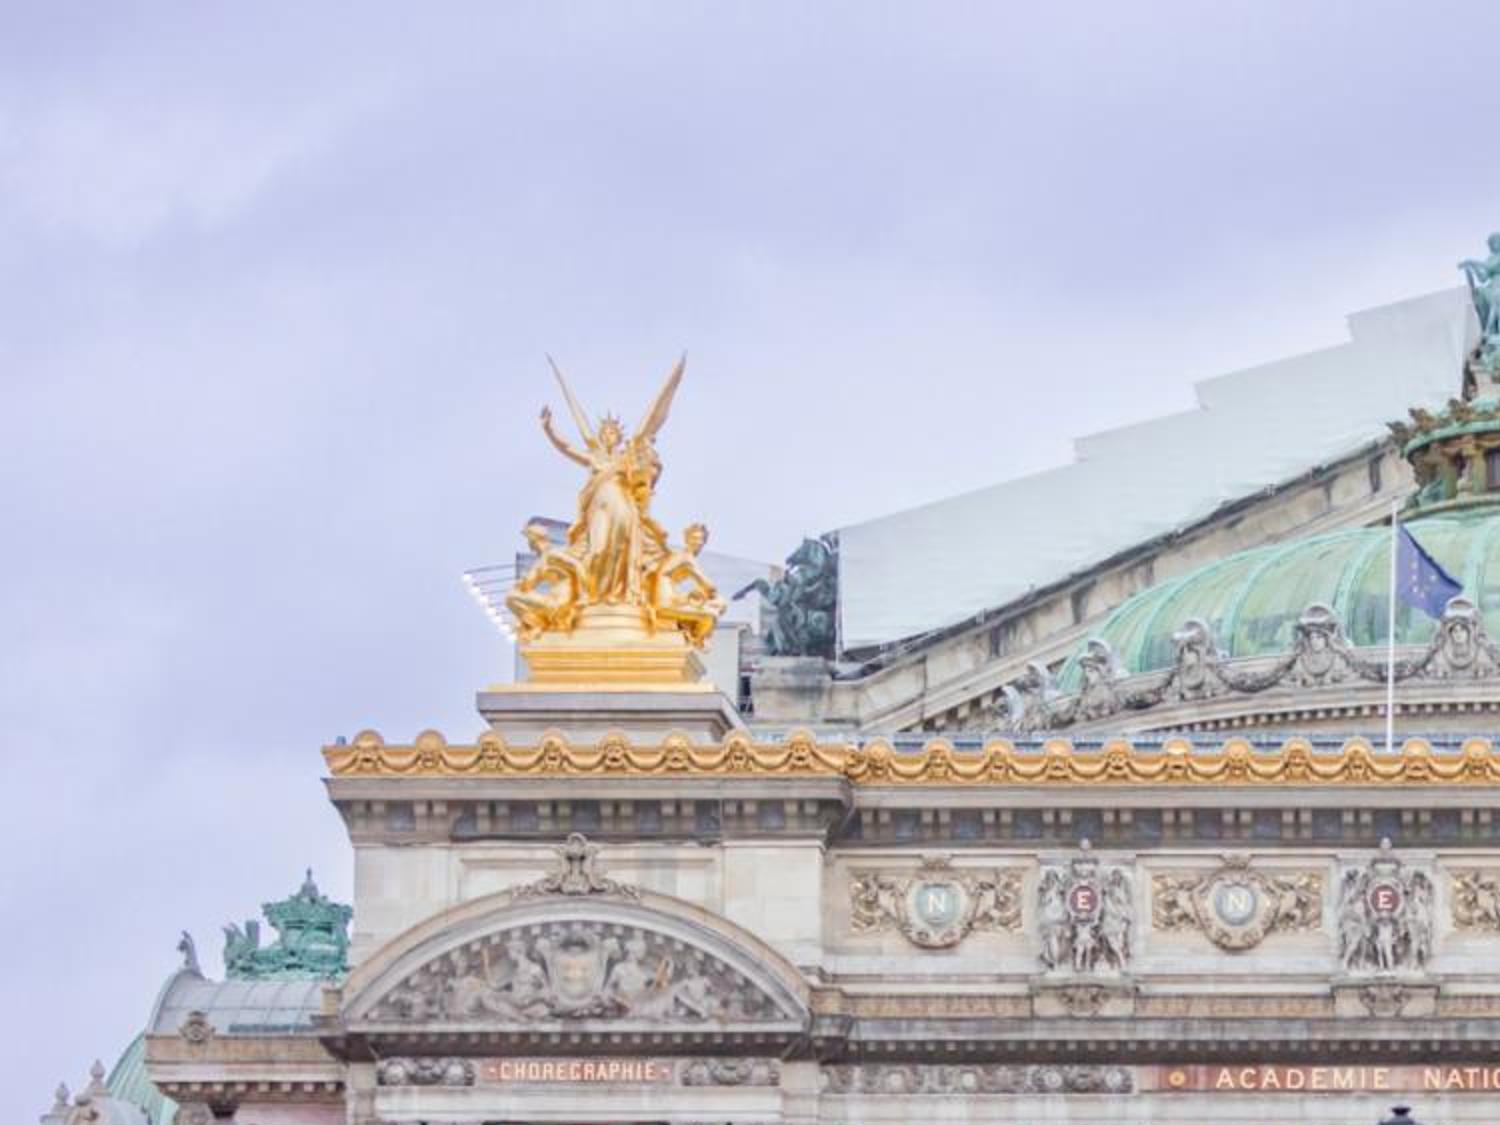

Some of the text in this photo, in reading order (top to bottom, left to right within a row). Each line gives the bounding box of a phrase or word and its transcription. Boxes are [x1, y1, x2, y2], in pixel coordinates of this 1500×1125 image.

[926, 892, 947, 914] N
[1076, 890, 1092, 910] E
[1227, 892, 1247, 914] N
[1376, 890, 1393, 910] E
[500, 1061, 656, 1081] CHOREGRAPHIE
[1215, 1067, 1390, 1090] ACADEMIE
